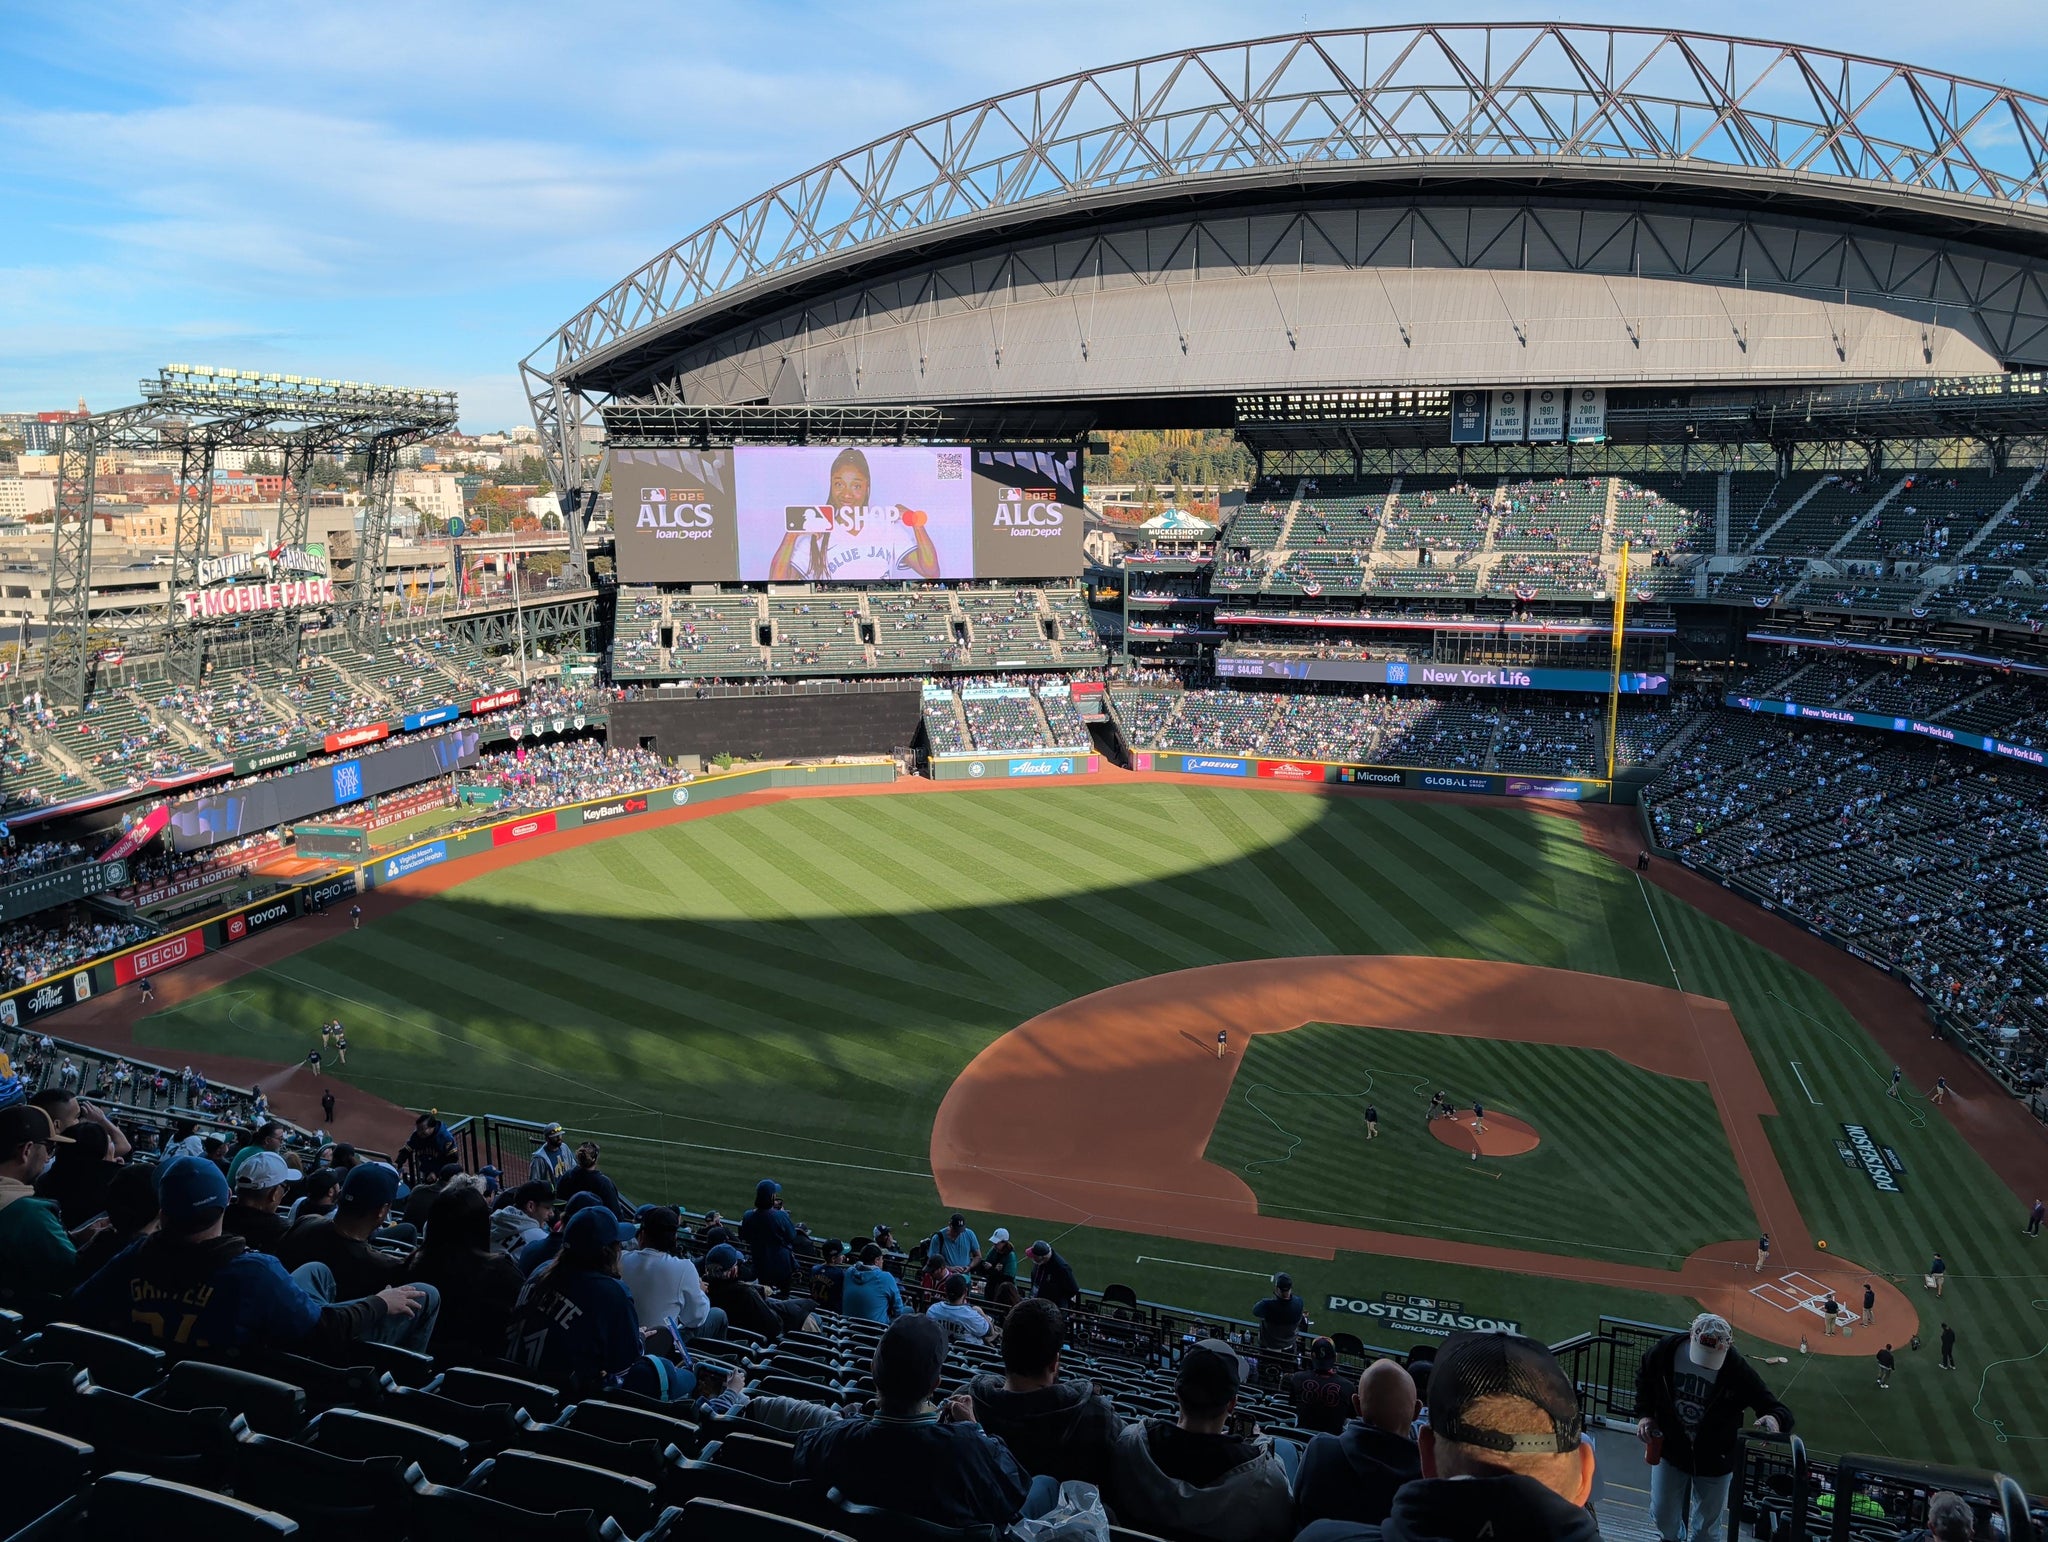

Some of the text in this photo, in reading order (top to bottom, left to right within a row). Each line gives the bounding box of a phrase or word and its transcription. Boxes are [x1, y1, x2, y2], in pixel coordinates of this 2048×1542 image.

[1500, 407, 1516, 416] 1995
[1539, 406, 1554, 416] 1997
[1505, 418, 1520, 426] WEST
[1544, 417, 1559, 425] WEST
[1584, 416, 1600, 424] WEST
[1491, 428, 1522, 436] CHAMPIONS
[1530, 427, 1561, 436] CHAMPIONS
[1570, 426, 1602, 435] CHAMPIONS
[670, 492, 705, 501] 2025
[1025, 492, 1057, 501] 2025
[636, 503, 714, 528] ALCS
[839, 505, 900, 531] SHOP
[993, 502, 1064, 526] ALCS
[656, 529, 713, 540] loanDepot
[1010, 527, 1062, 538] loanDepot
[201, 551, 250, 584] SEATTLE
[278, 548, 326, 575] MARINERS
[184, 578, 335, 618] T-MOBILE PARK
[1422, 669, 1531, 686] New York Life
[1802, 706, 1819, 719] New
[1820, 709, 1839, 720] York
[1840, 711, 1855, 722] Life
[1913, 722, 1928, 734] New
[1928, 725, 1942, 737] York
[1942, 727, 1954, 740] Life
[259, 750, 297, 766] STARBUCKS
[1997, 743, 2015, 755] New
[2015, 746, 2030, 760] York
[2029, 750, 2043, 763] Life
[337, 765, 355, 779] NEW
[1012, 760, 1052, 775] Alaska
[1200, 761, 1239, 770] BOEING
[335, 775, 358, 790] YORK
[1357, 770, 1401, 783] Microsoft
[1424, 776, 1468, 788] GLOBAL
[339, 785, 358, 798] LIFE
[376, 814, 394, 827] BEST
[394, 811, 402, 821] IN
[402, 807, 416, 819] THE
[583, 803, 625, 822] KeyBank
[513, 824, 537, 835] Nintendo
[399, 847, 433, 865] Virginia Mason
[400, 853, 442, 872] Franciscan Health
[139, 859, 258, 907] BEST IN THE NORTHWST
[314, 883, 341, 903] eero
[248, 904, 288, 927] TOYOTA
[138, 944, 184, 969] BECU
[75, 975, 88, 987] Lite
[28, 986, 63, 1014] Miller
[37, 985, 52, 999] IT'S
[1, 1002, 15, 1016] Lite
[45, 996, 63, 1009] TIME
[1844, 1124, 1900, 1191] POSTSEASON
[1385, 1292, 1460, 1310] 20 25
[1328, 1295, 1519, 1336] POSTSEASON
[1390, 1321, 1450, 1337] loanDepot
[1301, 1379, 1341, 1407] 86
